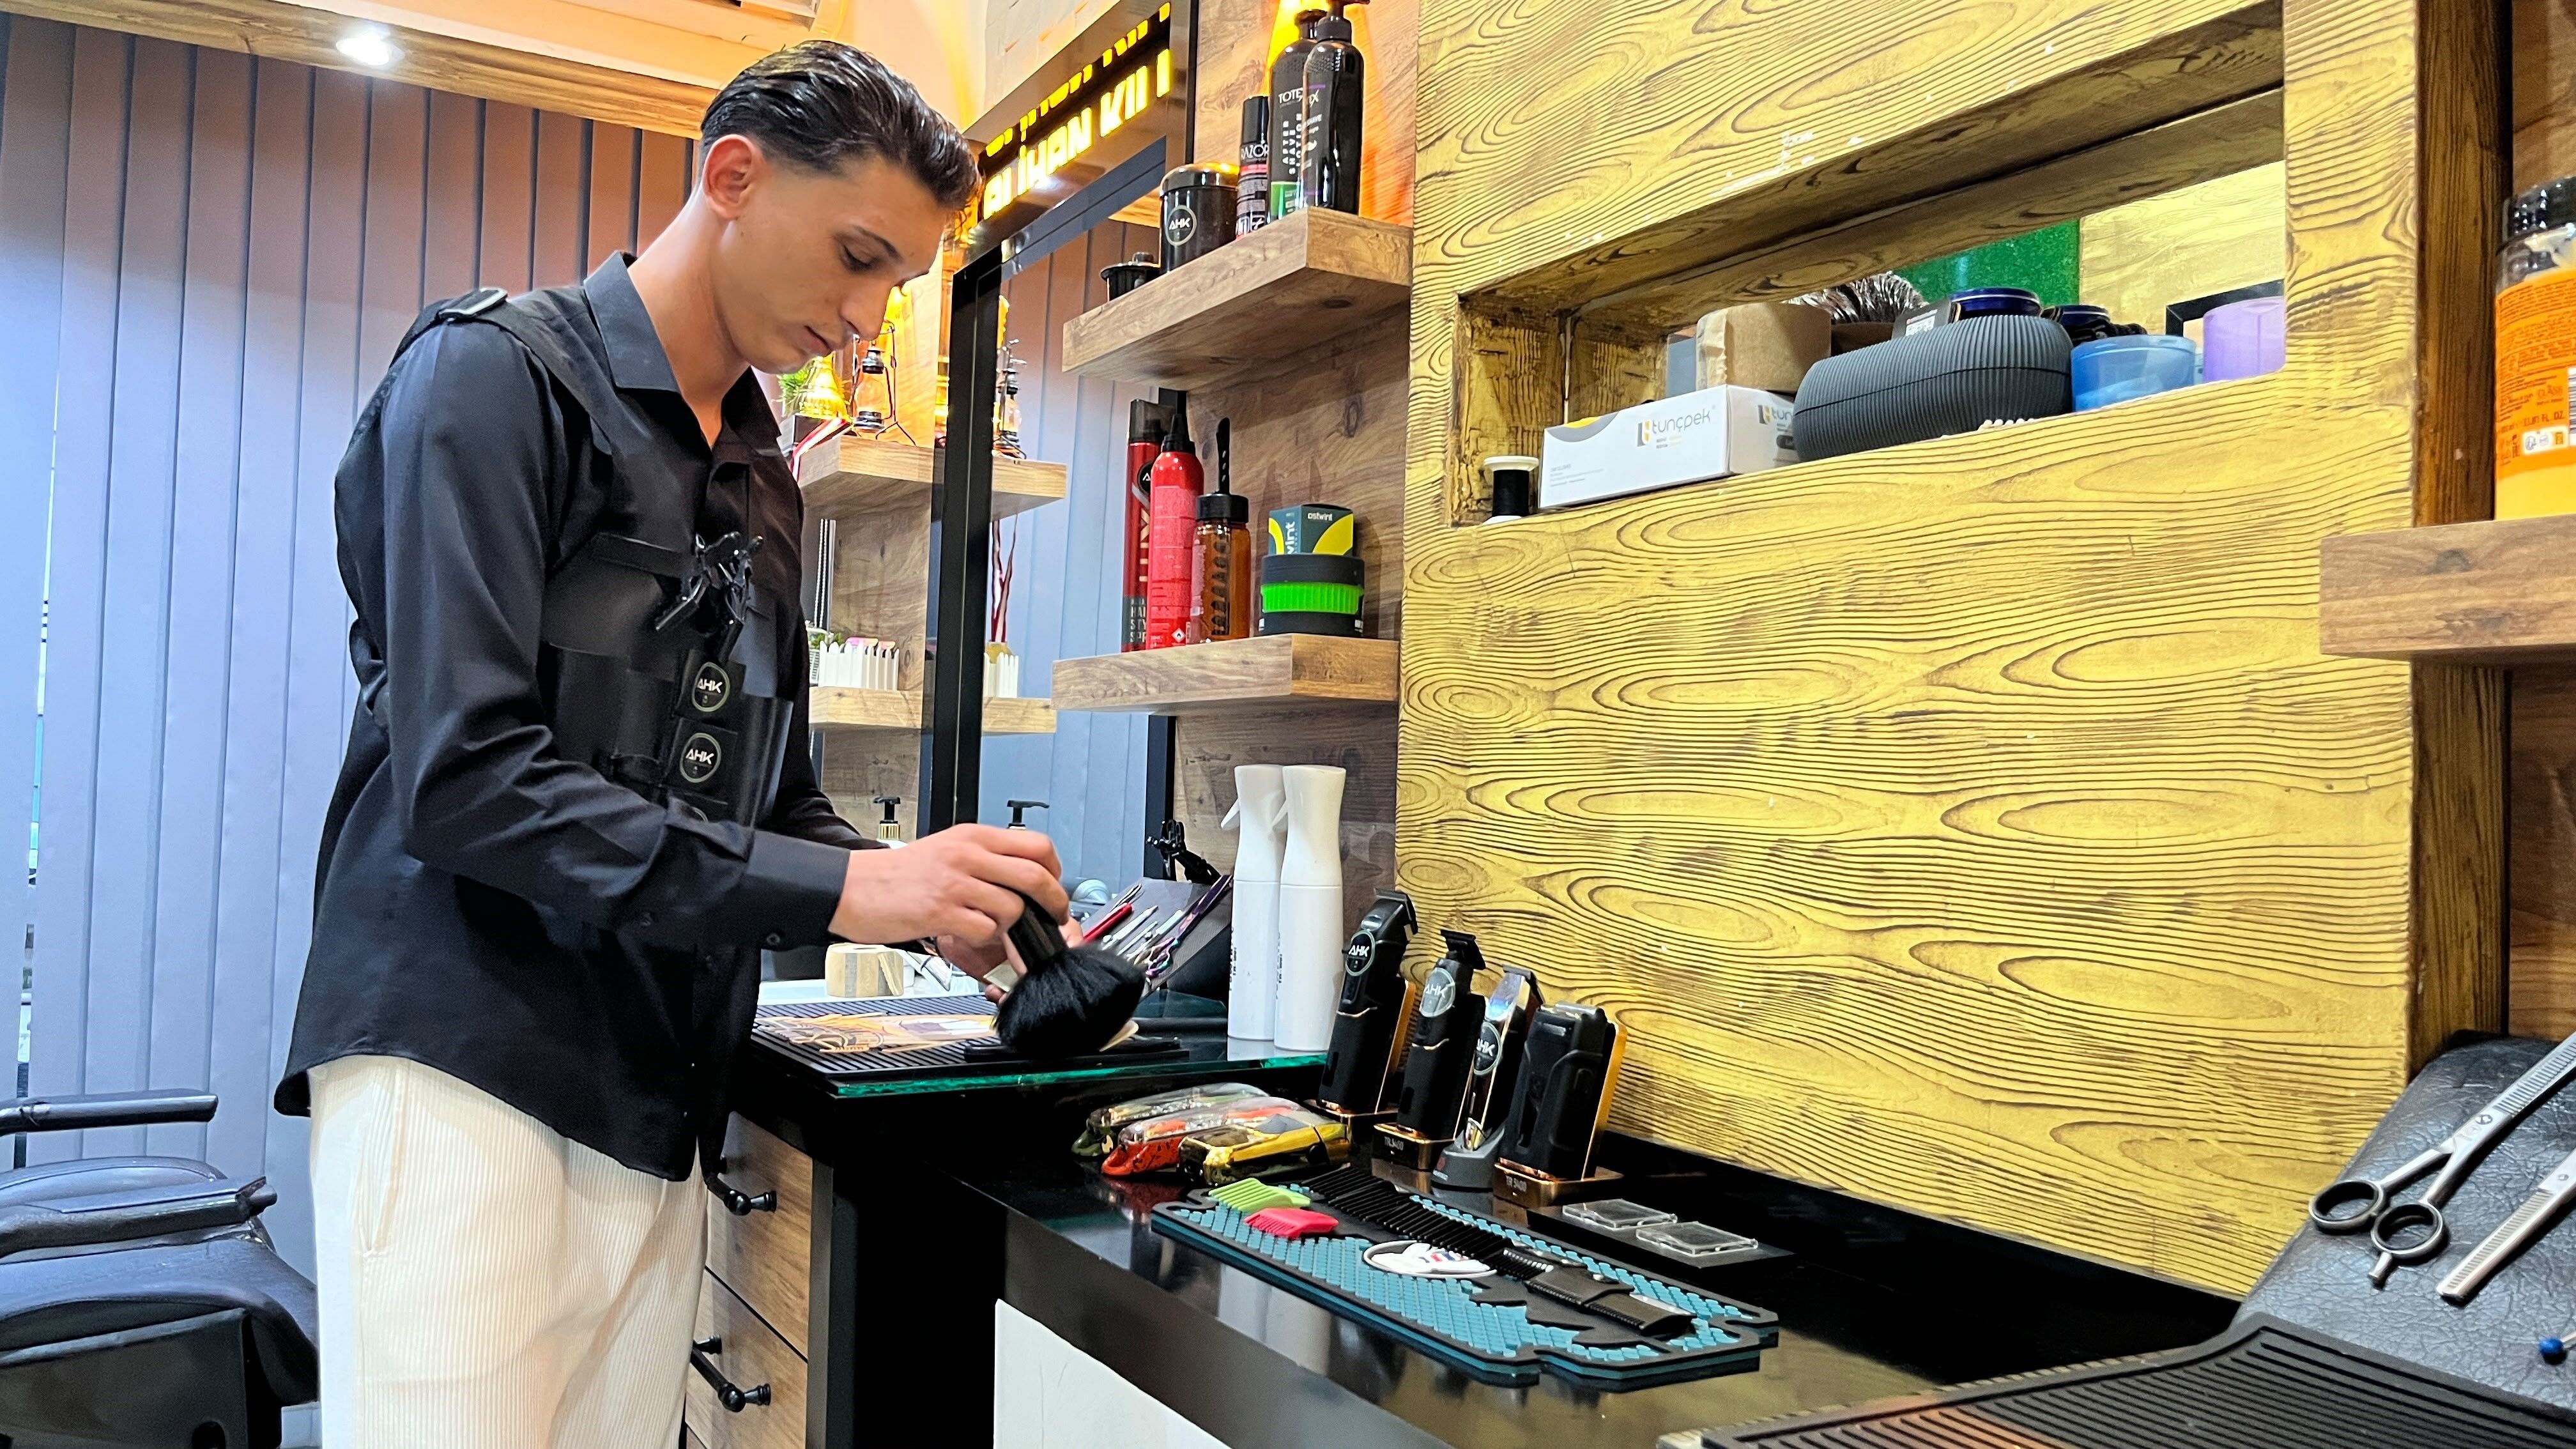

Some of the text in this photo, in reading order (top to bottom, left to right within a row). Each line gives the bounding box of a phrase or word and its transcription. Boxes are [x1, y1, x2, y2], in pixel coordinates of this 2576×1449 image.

[1169, 217, 1190, 230] AHK
[1652, 407, 1710, 434] tunçpek
[697, 678, 723, 694] AHK
[686, 748, 714, 765] AHK
[1348, 944, 1370, 957] AHK
[1425, 984, 1449, 998] AHK
